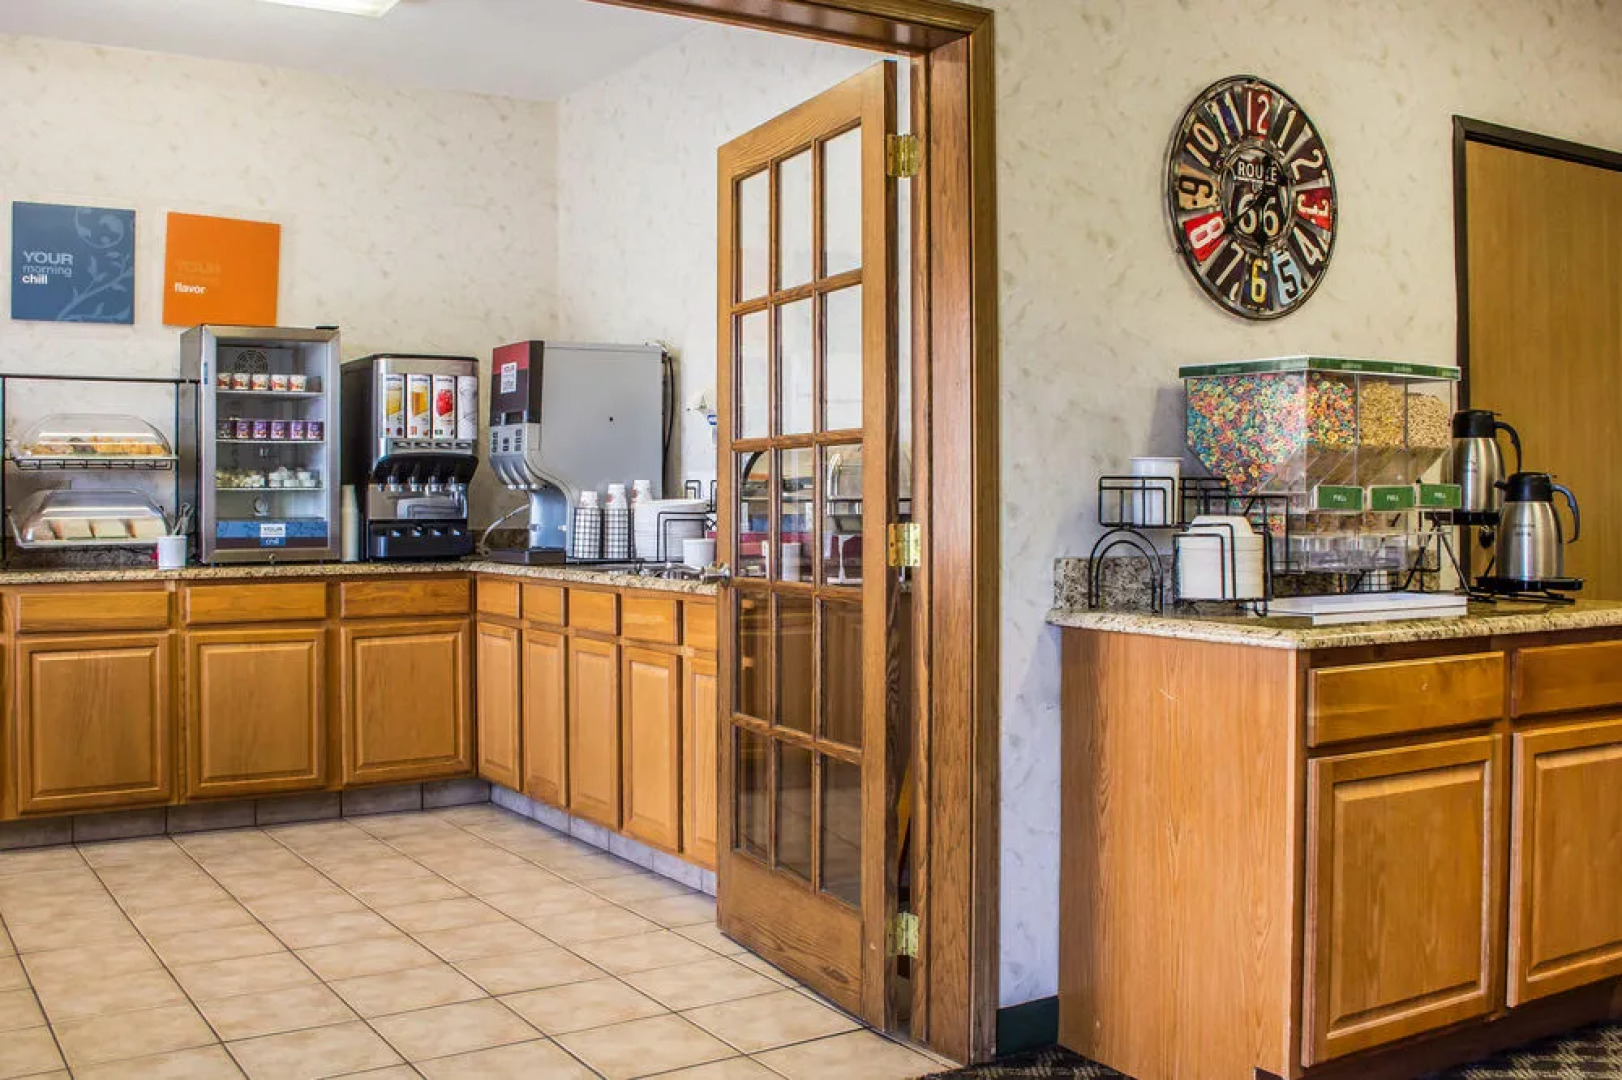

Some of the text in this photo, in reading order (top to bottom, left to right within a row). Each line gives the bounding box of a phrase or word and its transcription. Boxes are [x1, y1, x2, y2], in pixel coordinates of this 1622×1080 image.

[1247, 90, 1271, 135] 12
[1277, 109, 1297, 149] 1
[1185, 122, 1219, 168] 10
[1236, 161, 1278, 181] ROUE
[1290, 148, 1324, 180] 2
[1179, 174, 1214, 199] 9
[1238, 193, 1279, 236] 66
[1296, 193, 1330, 217] 3
[1189, 216, 1225, 249] 8
[1293, 226, 1326, 267] 4
[22, 265, 73, 278] morning
[23, 250, 74, 266] YOUR
[1214, 241, 1245, 286] 7
[22, 273, 48, 285] chill
[174, 281, 207, 295] flavor
[1251, 258, 1269, 304] 6
[1277, 259, 1299, 299] 5
